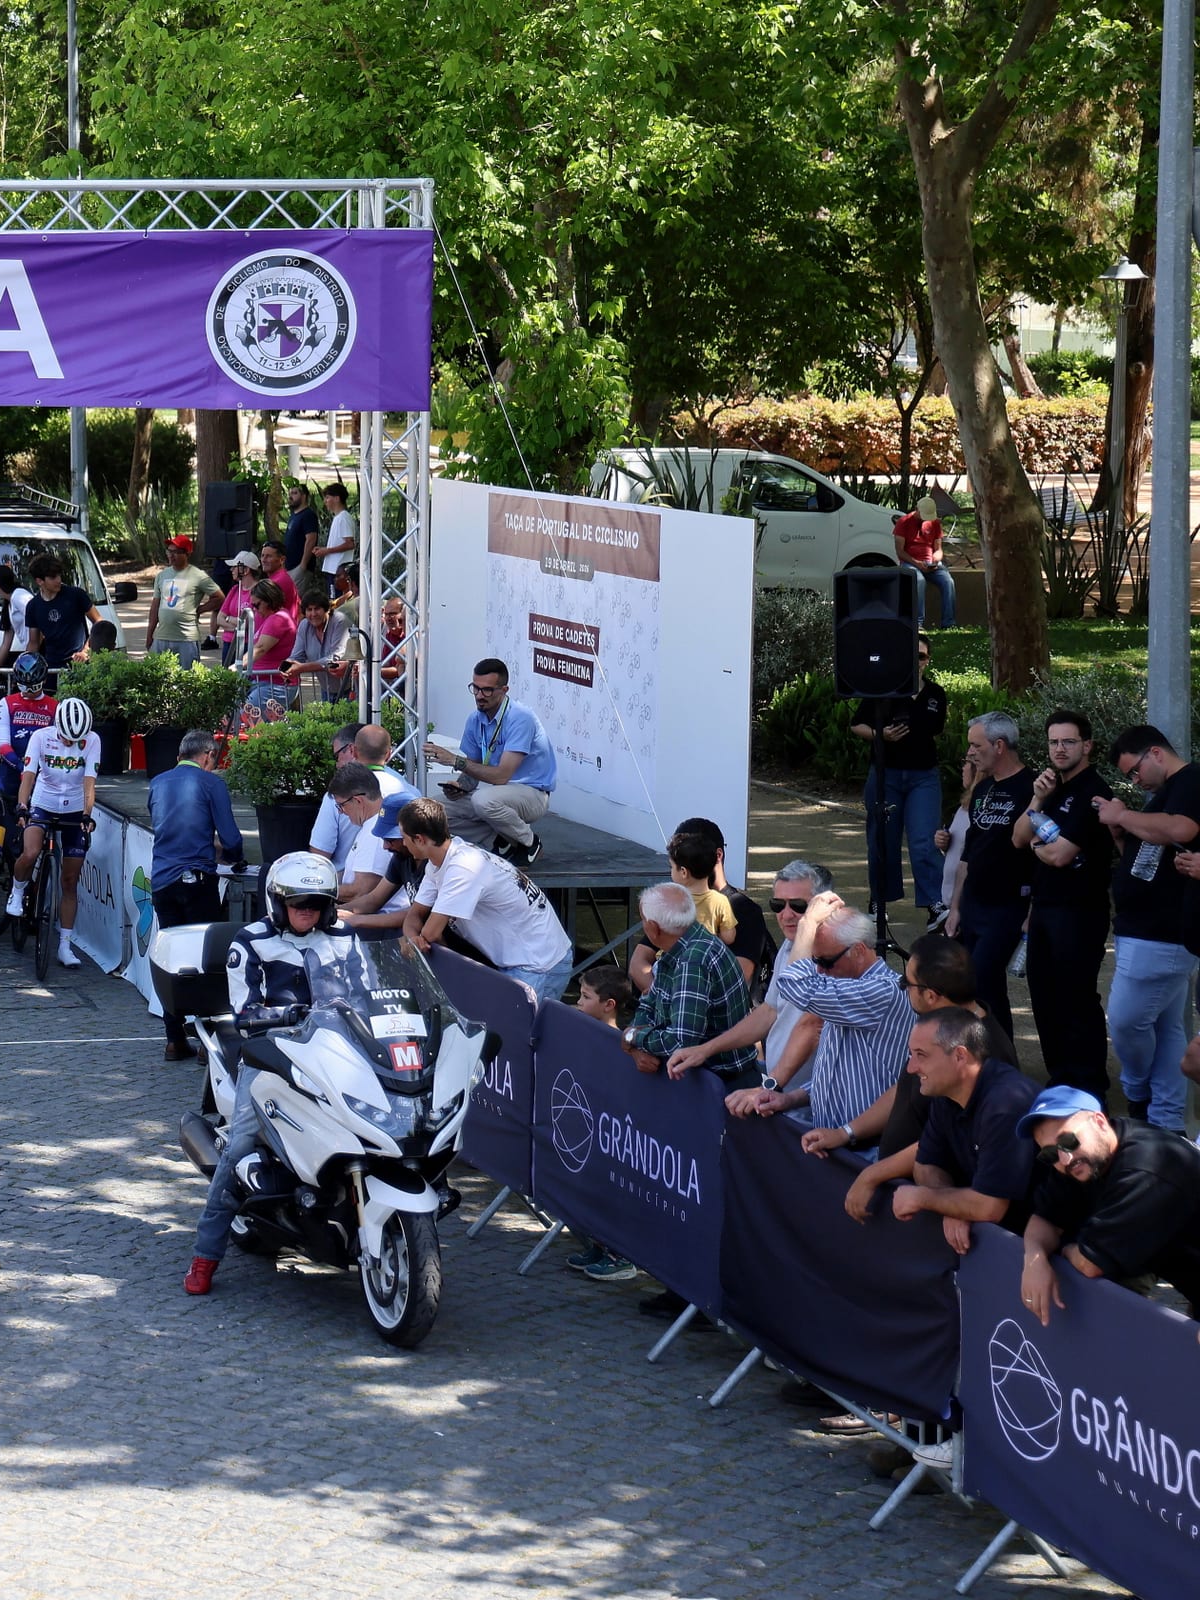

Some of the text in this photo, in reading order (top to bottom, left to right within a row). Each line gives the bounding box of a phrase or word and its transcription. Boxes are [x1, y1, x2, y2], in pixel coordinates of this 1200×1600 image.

[215, 305, 225, 320] DE
[226, 260, 269, 293] CICLISMO
[285, 257, 301, 267] DO
[313, 267, 344, 307] DISTRITO
[338, 323, 347, 337] DE
[504, 512, 639, 550] TAÇA DE PORTUGAL DE CICLISMO
[532, 621, 596, 647] PROVA DE CADETES
[536, 654, 591, 681] PROVA FEMININA
[370, 989, 410, 1001] MOTO
[383, 1003, 402, 1014] TV
[393, 1045, 419, 1068] M
[598, 1111, 701, 1205] GRÂNDOLA
[609, 1170, 687, 1222] MUNICÍPIO
